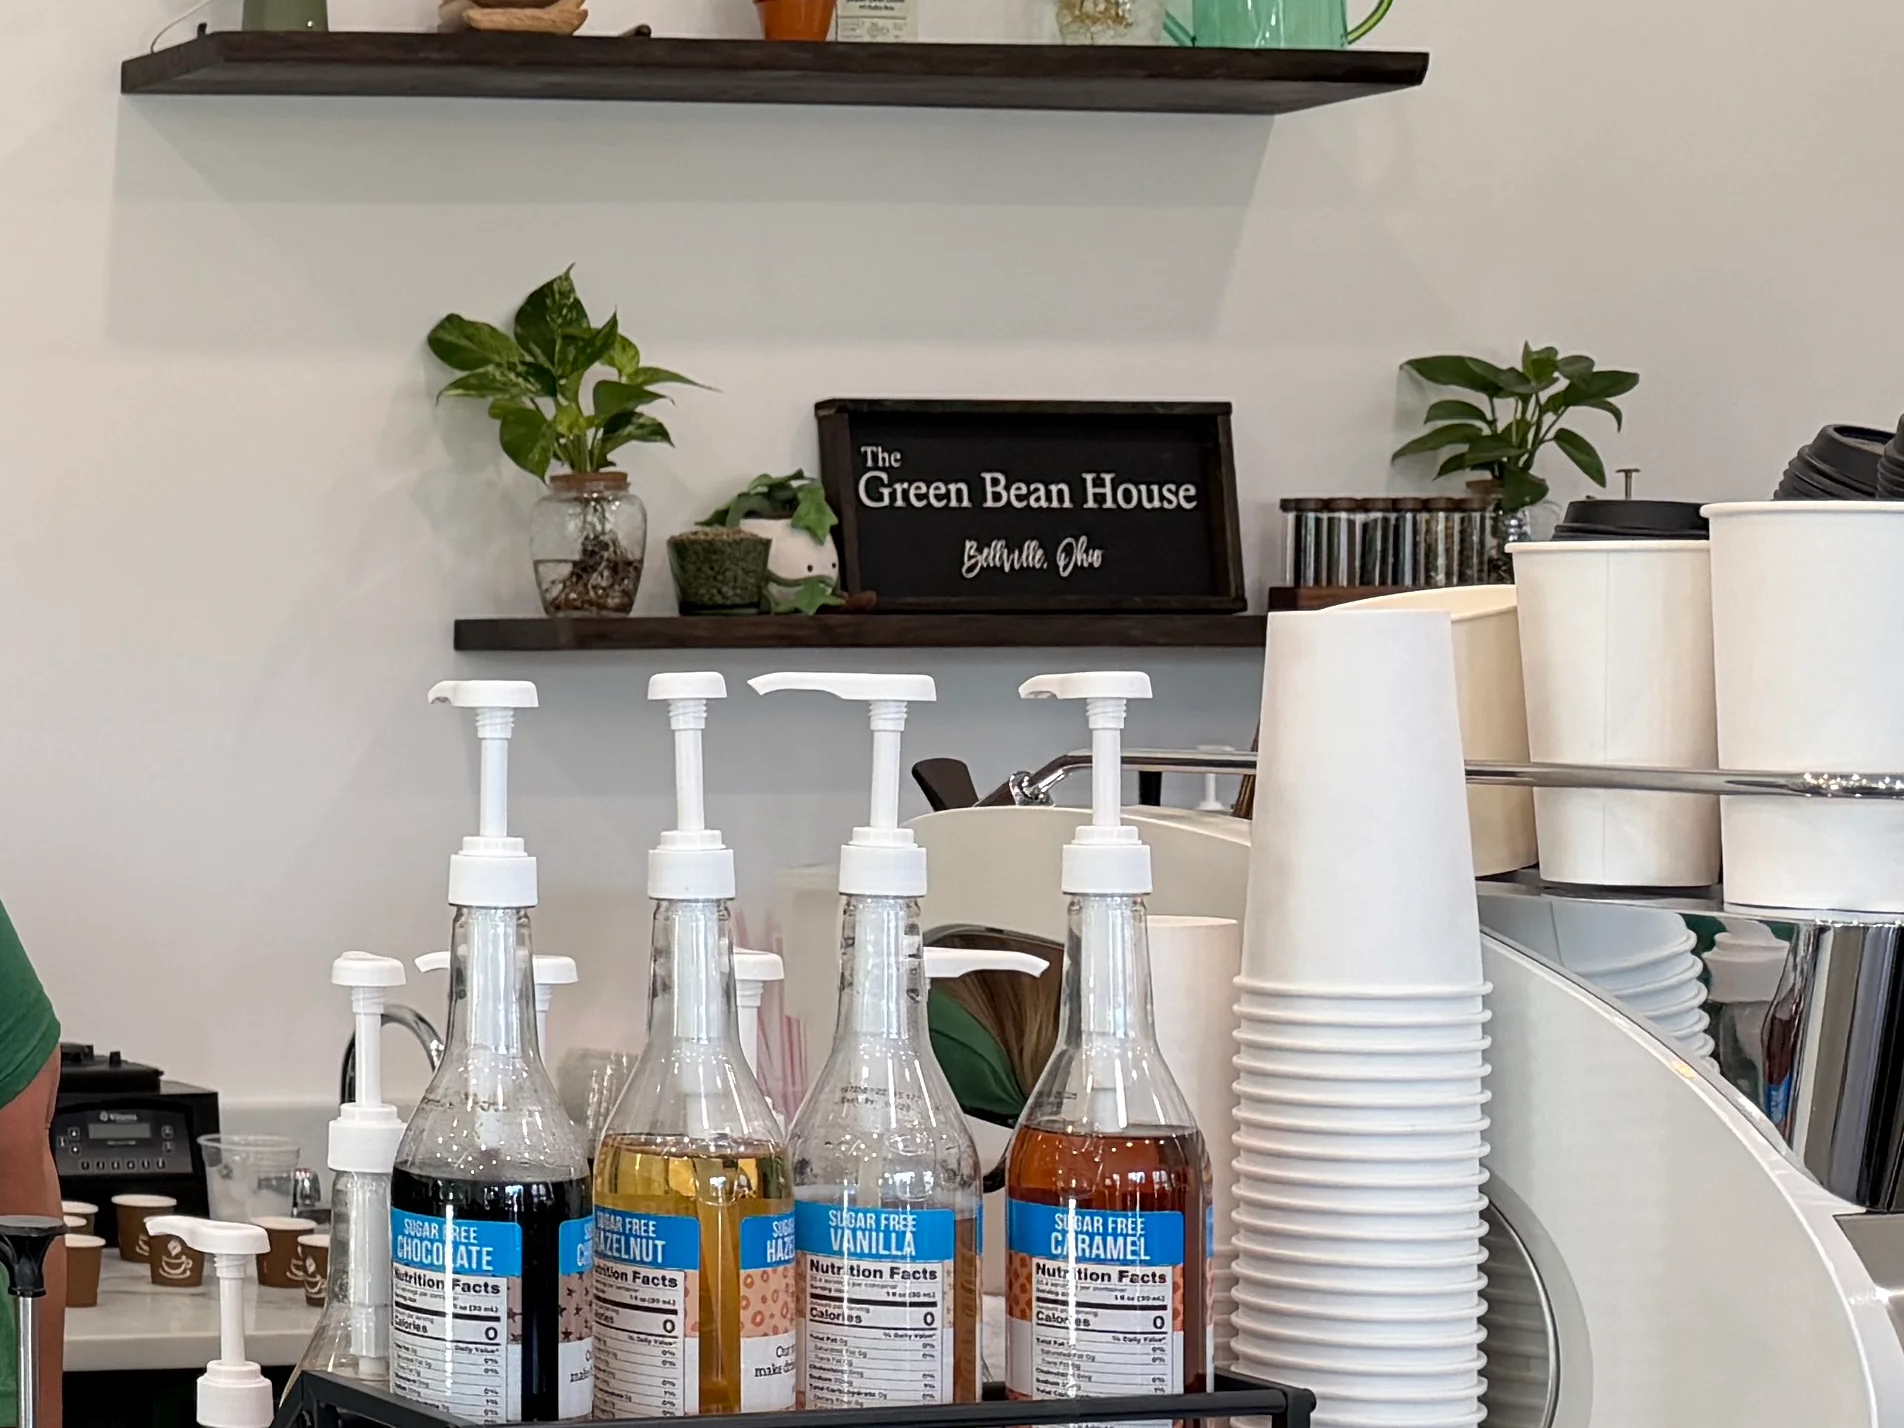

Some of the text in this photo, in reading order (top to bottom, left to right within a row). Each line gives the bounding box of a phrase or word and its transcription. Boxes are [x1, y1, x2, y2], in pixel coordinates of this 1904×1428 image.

[860, 446, 902, 469] The
[858, 470, 1198, 511] Green Bean House
[1056, 535, 1103, 578] Ohio
[403, 1218, 440, 1240] SUGAR
[625, 1218, 658, 1238] FREE
[828, 1209, 918, 1233] SUGAR FREE
[1108, 1217, 1146, 1235] FREE
[830, 1227, 916, 1256] VANILLA
[809, 1258, 938, 1281] Nutrtion Facts
[452, 1277, 501, 1295] Facts
